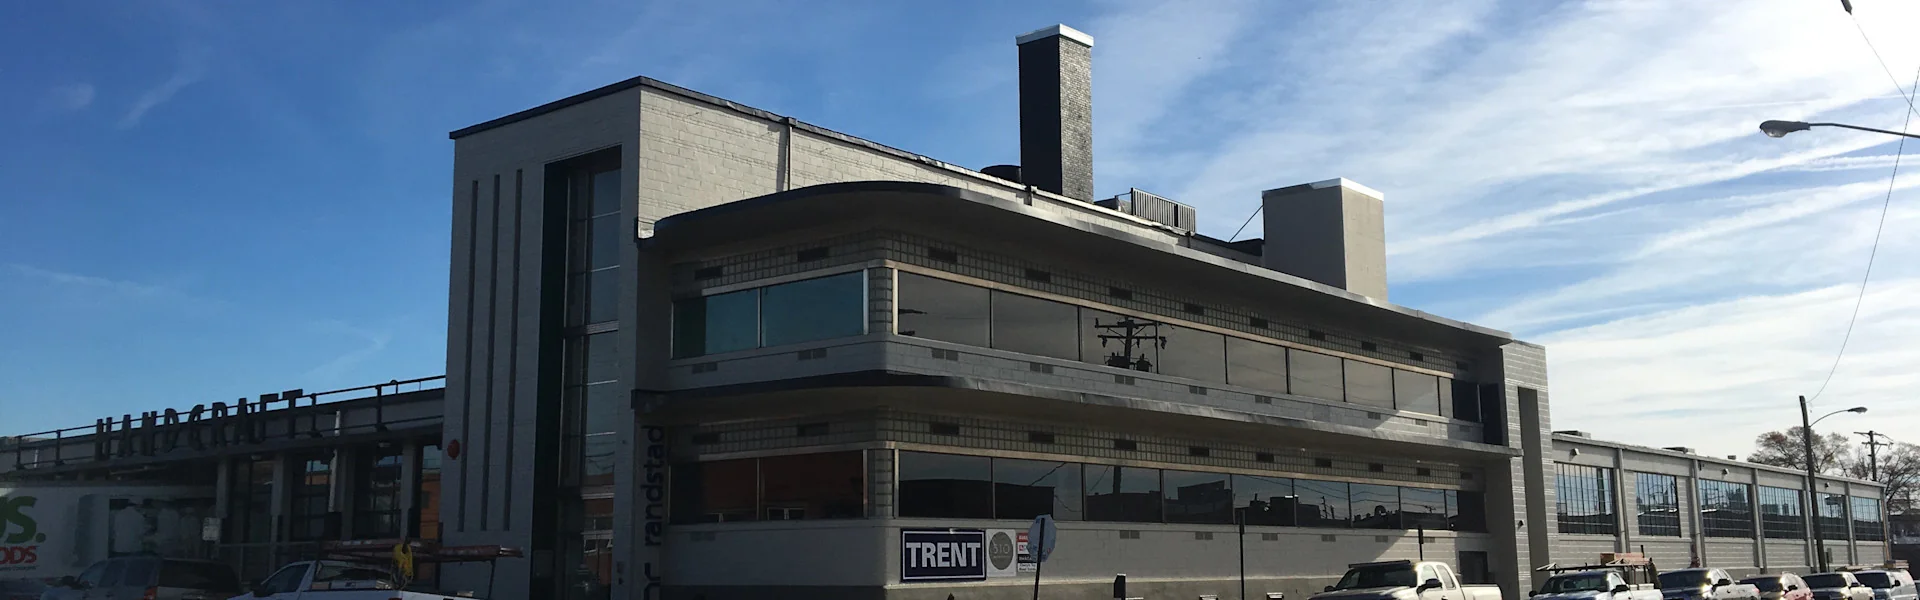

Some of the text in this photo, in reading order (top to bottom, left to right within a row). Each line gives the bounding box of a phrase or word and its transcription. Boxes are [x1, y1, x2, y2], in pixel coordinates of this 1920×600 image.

[95, 388, 303, 462] HANDCRAFT
[640, 425, 665, 547] randstad
[906, 542, 981, 568] TRENT
